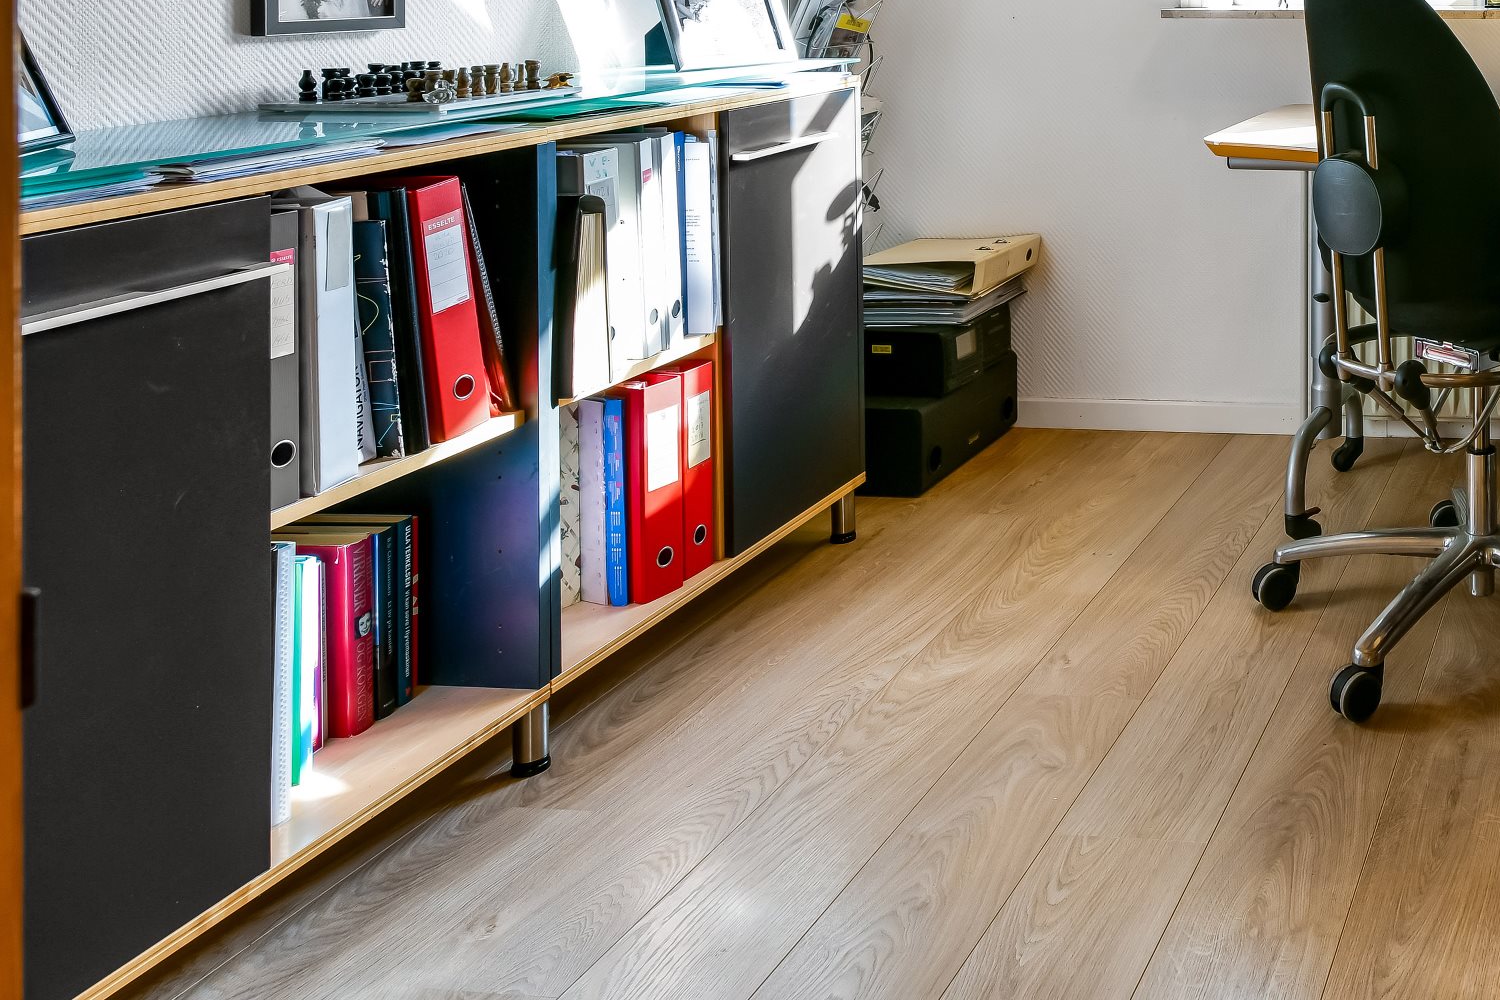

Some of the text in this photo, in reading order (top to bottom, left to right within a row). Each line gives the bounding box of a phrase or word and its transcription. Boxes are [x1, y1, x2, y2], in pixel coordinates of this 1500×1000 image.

[428, 215, 456, 231] ESSELTE
[353, 544, 367, 613] VIRKNER
[356, 641, 368, 722] OG KONGEN
